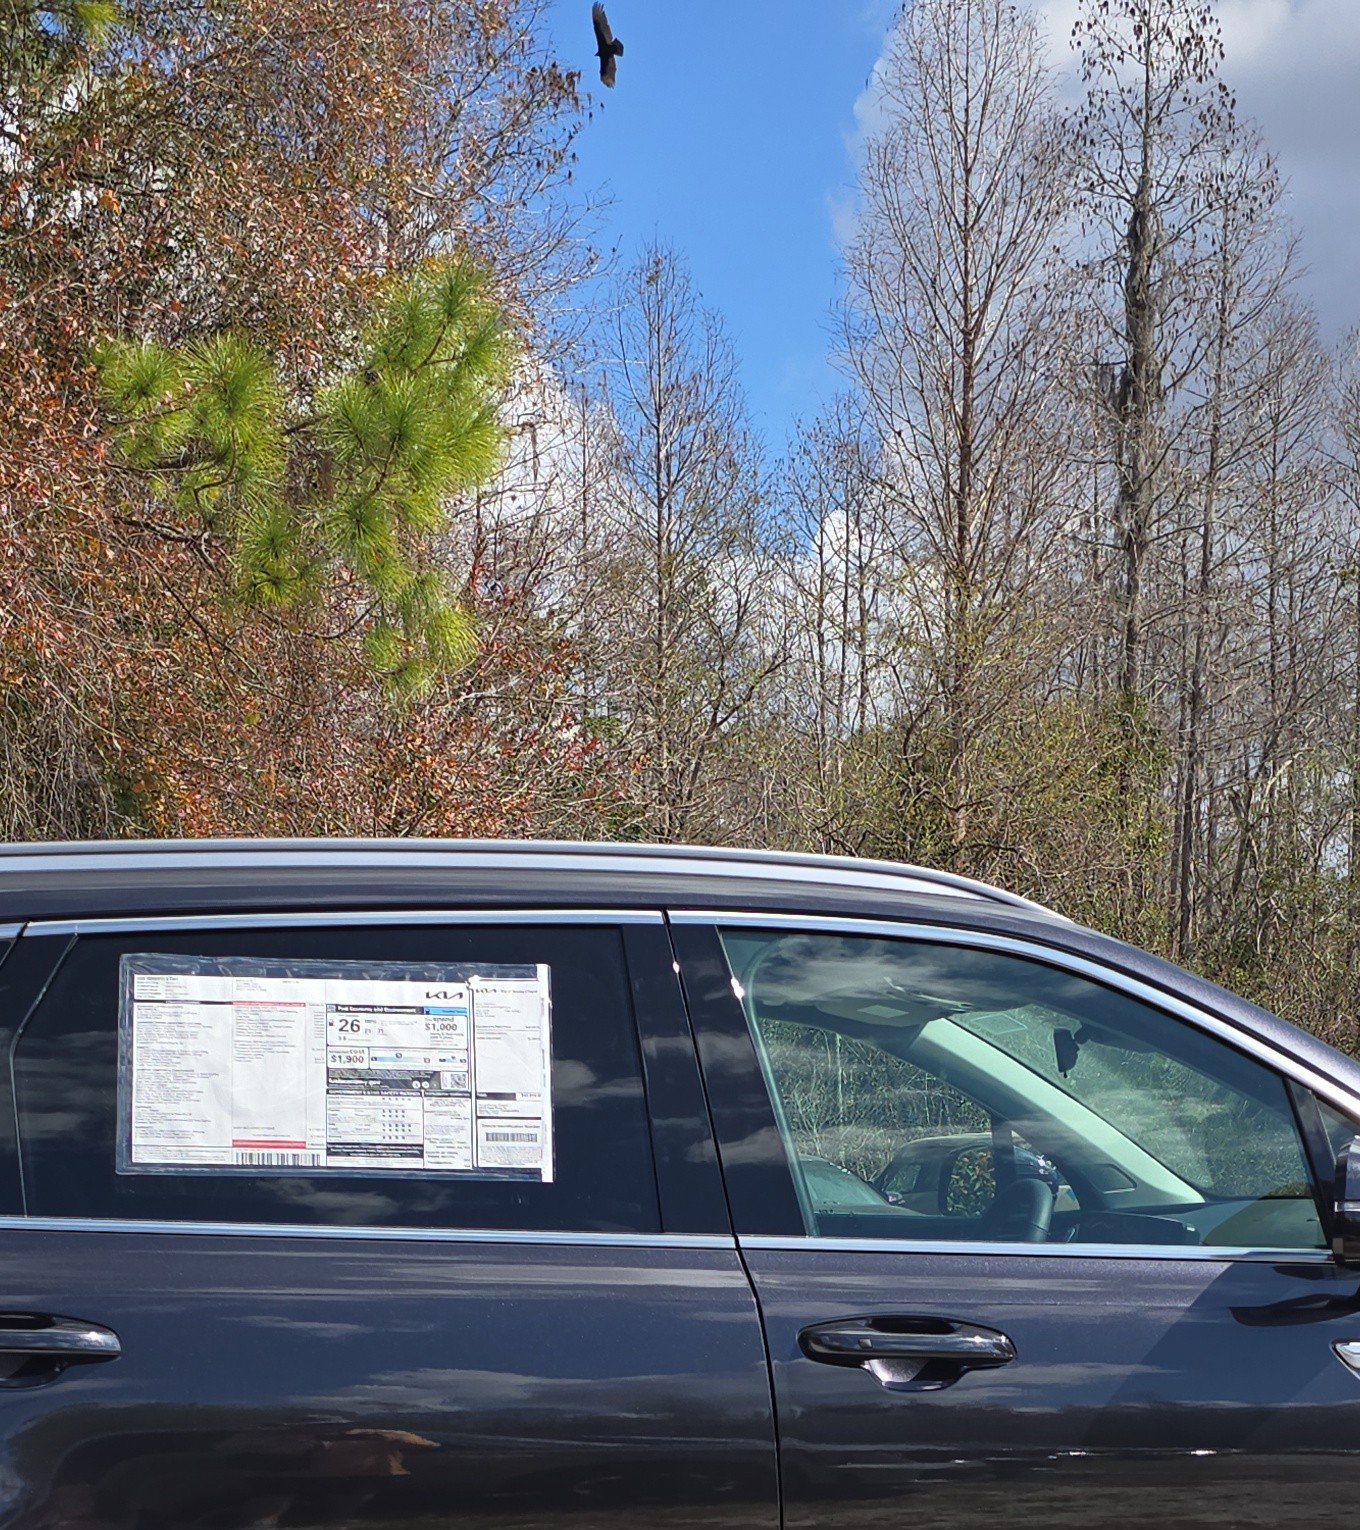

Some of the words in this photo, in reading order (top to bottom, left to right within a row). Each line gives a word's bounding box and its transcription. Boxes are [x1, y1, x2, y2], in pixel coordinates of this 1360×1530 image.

[425, 990, 463, 1000] KIA
[338, 1018, 361, 1033] 26
[424, 1022, 458, 1032] $1,000
[330, 1054, 365, 1064] $1,900
